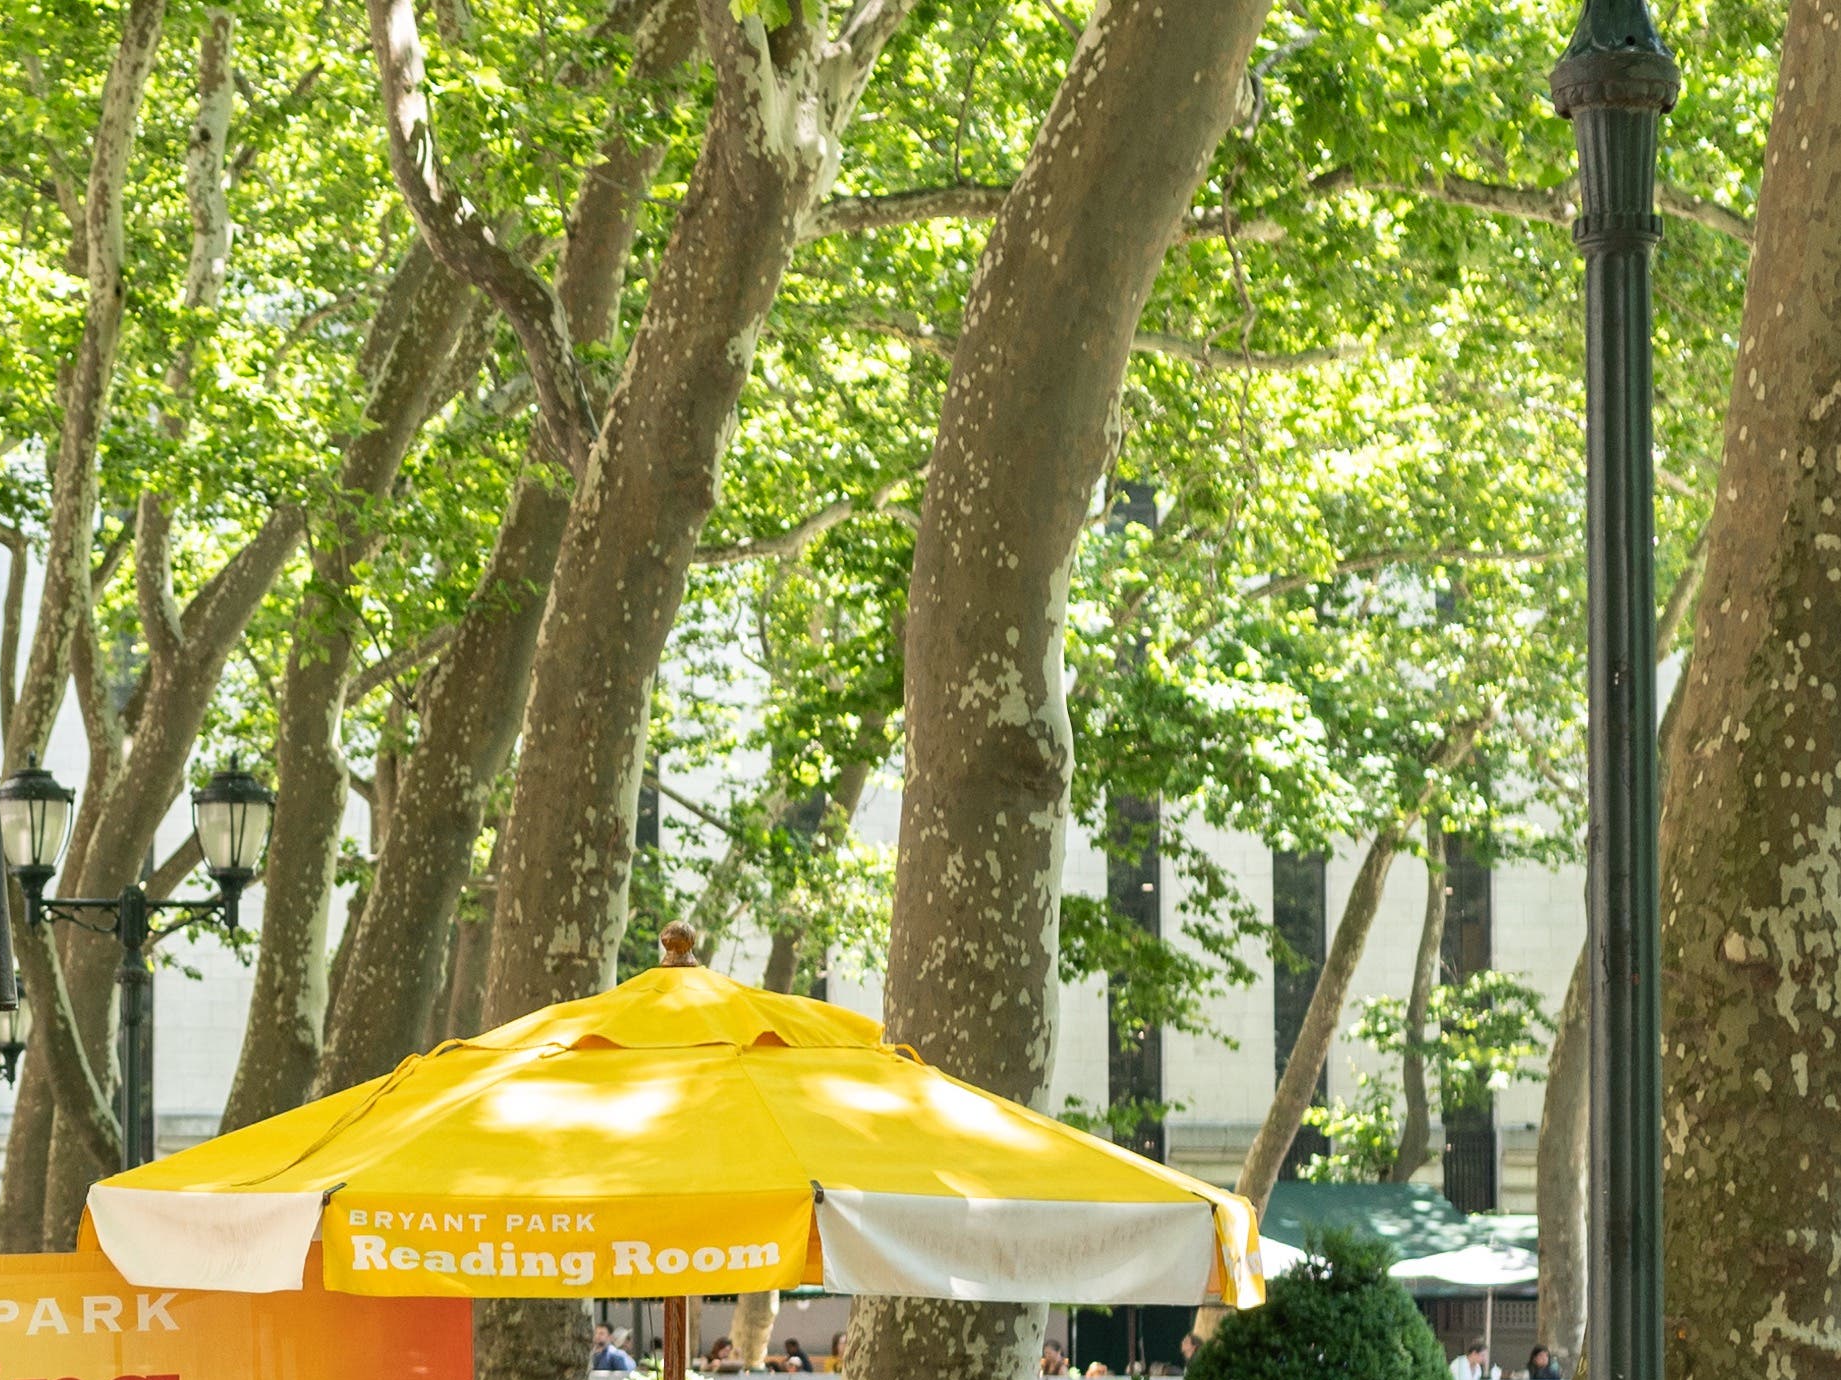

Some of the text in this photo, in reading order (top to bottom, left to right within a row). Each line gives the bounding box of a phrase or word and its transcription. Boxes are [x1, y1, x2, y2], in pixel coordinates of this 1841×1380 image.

[349, 1209, 596, 1232] BRYANT PARK
[351, 1235, 780, 1285] Reading Room
